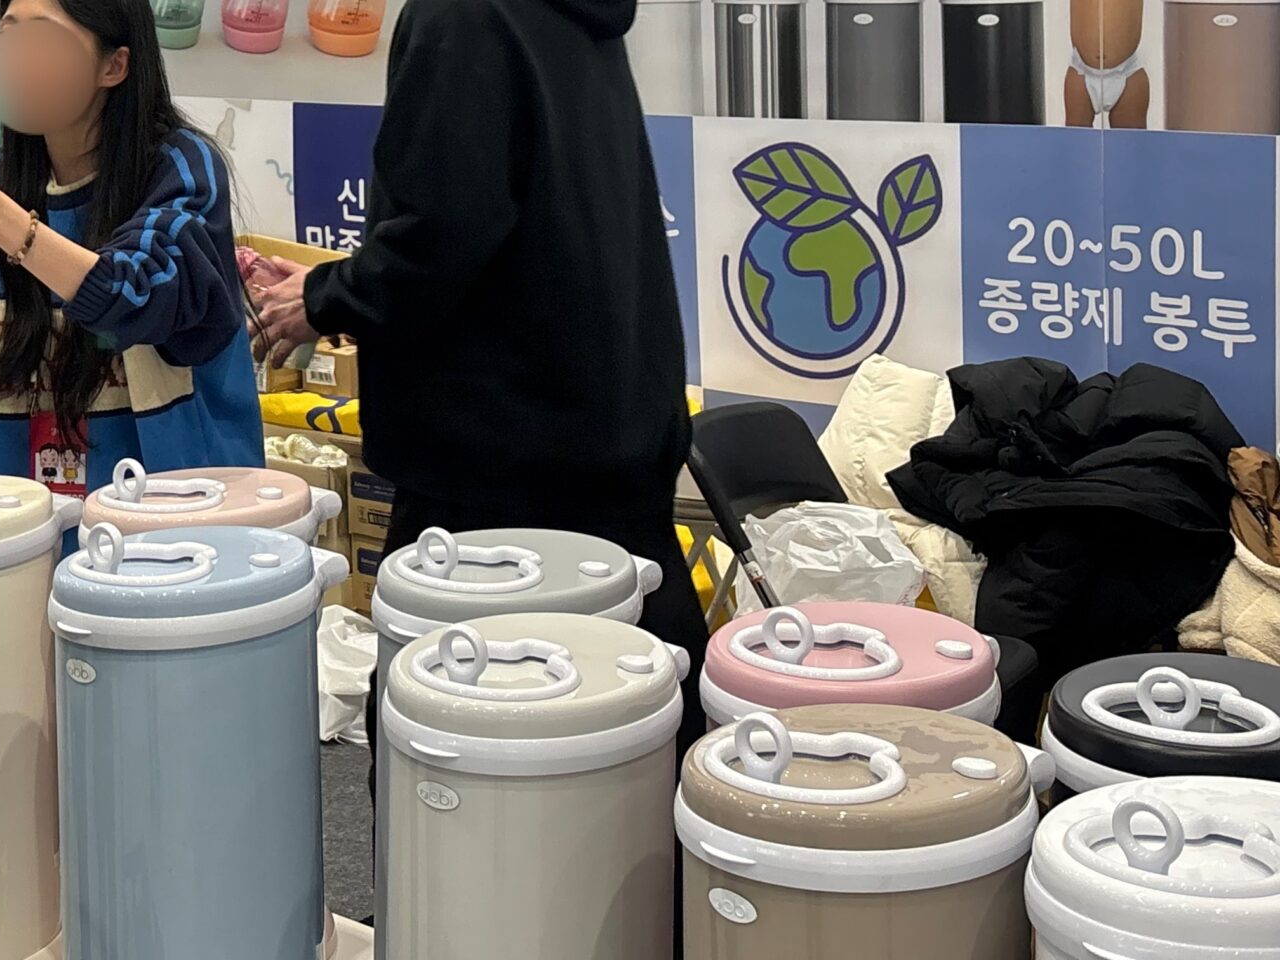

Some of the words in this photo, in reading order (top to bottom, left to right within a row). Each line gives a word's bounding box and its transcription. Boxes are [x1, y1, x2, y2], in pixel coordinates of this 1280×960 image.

[1007, 216, 1226, 281] 20~50L
[978, 277, 1124, 347] 종량제
[1142, 291, 1258, 360] 봉투
